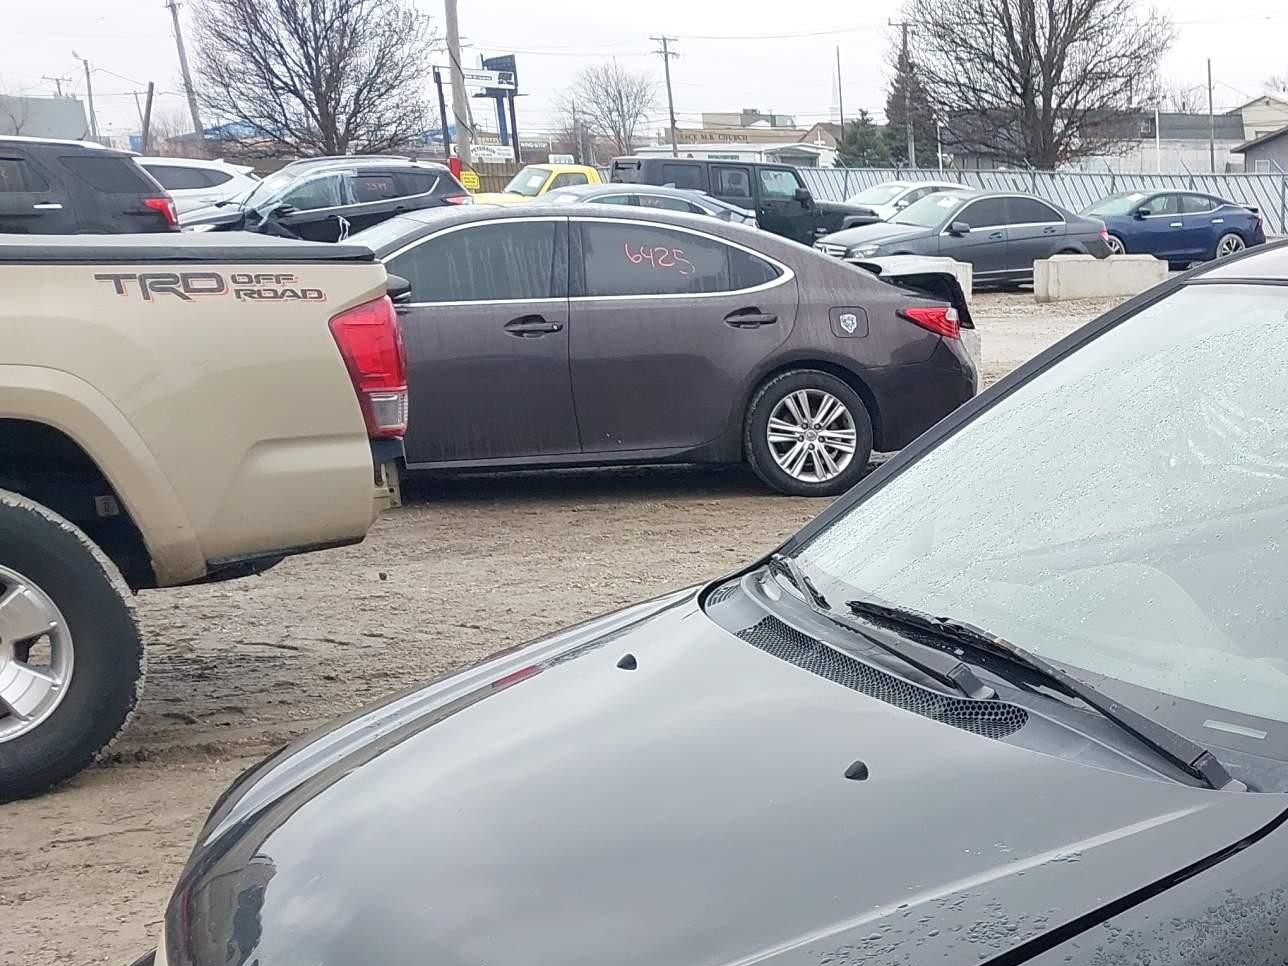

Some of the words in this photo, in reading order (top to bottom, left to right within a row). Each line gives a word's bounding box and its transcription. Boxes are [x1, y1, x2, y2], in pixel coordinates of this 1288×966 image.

[624, 243, 696, 275] 6425
[94, 271, 228, 302] TRD
[231, 273, 298, 286] OFF
[234, 287, 327, 302] ROAD
